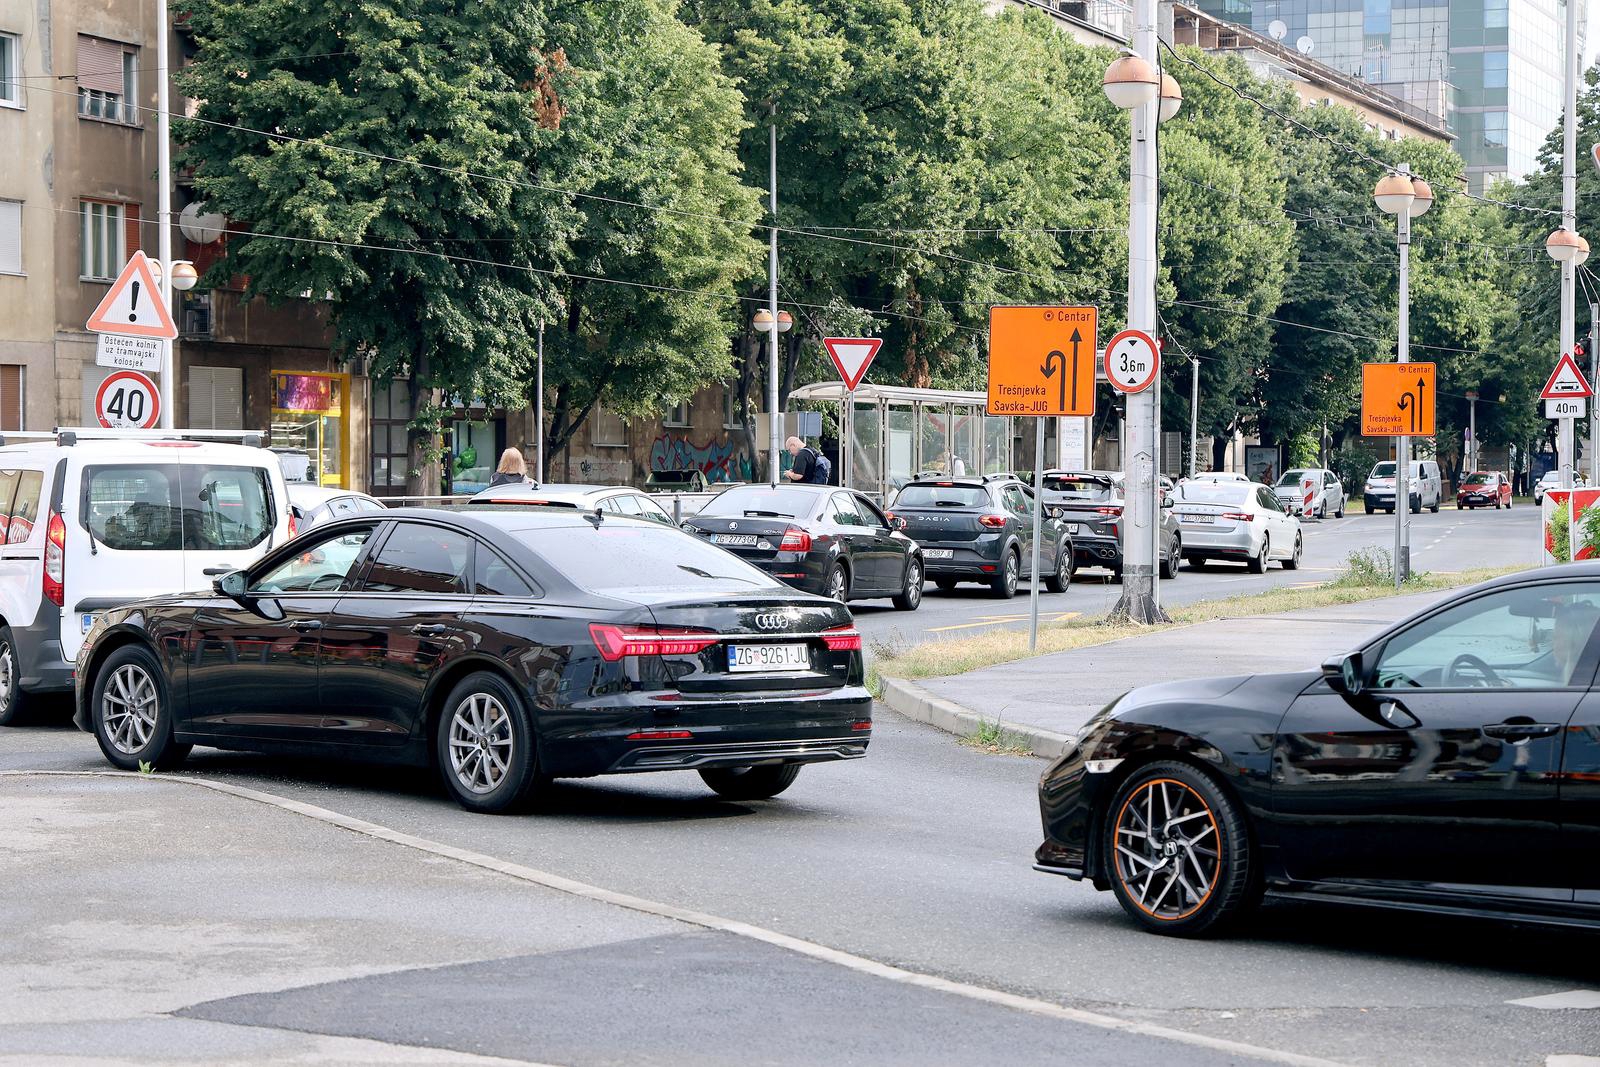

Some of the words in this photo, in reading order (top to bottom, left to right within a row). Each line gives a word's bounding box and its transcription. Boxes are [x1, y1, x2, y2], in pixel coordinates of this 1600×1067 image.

[1058, 311, 1091, 321] Centar
[136, 340, 157, 350] kolnik
[117, 347, 155, 359] tramvajski
[114, 357, 144, 368] kolosjek
[998, 384, 1046, 397] Trešnjevka
[107, 387, 144, 421] 40
[994, 400, 1048, 412] Savska-JUG
[1369, 415, 1402, 423] Trešnjevka
[1366, 425, 1403, 433] Savska-JUG
[715, 534, 725, 543] ZG
[737, 647, 753, 665] ZG
